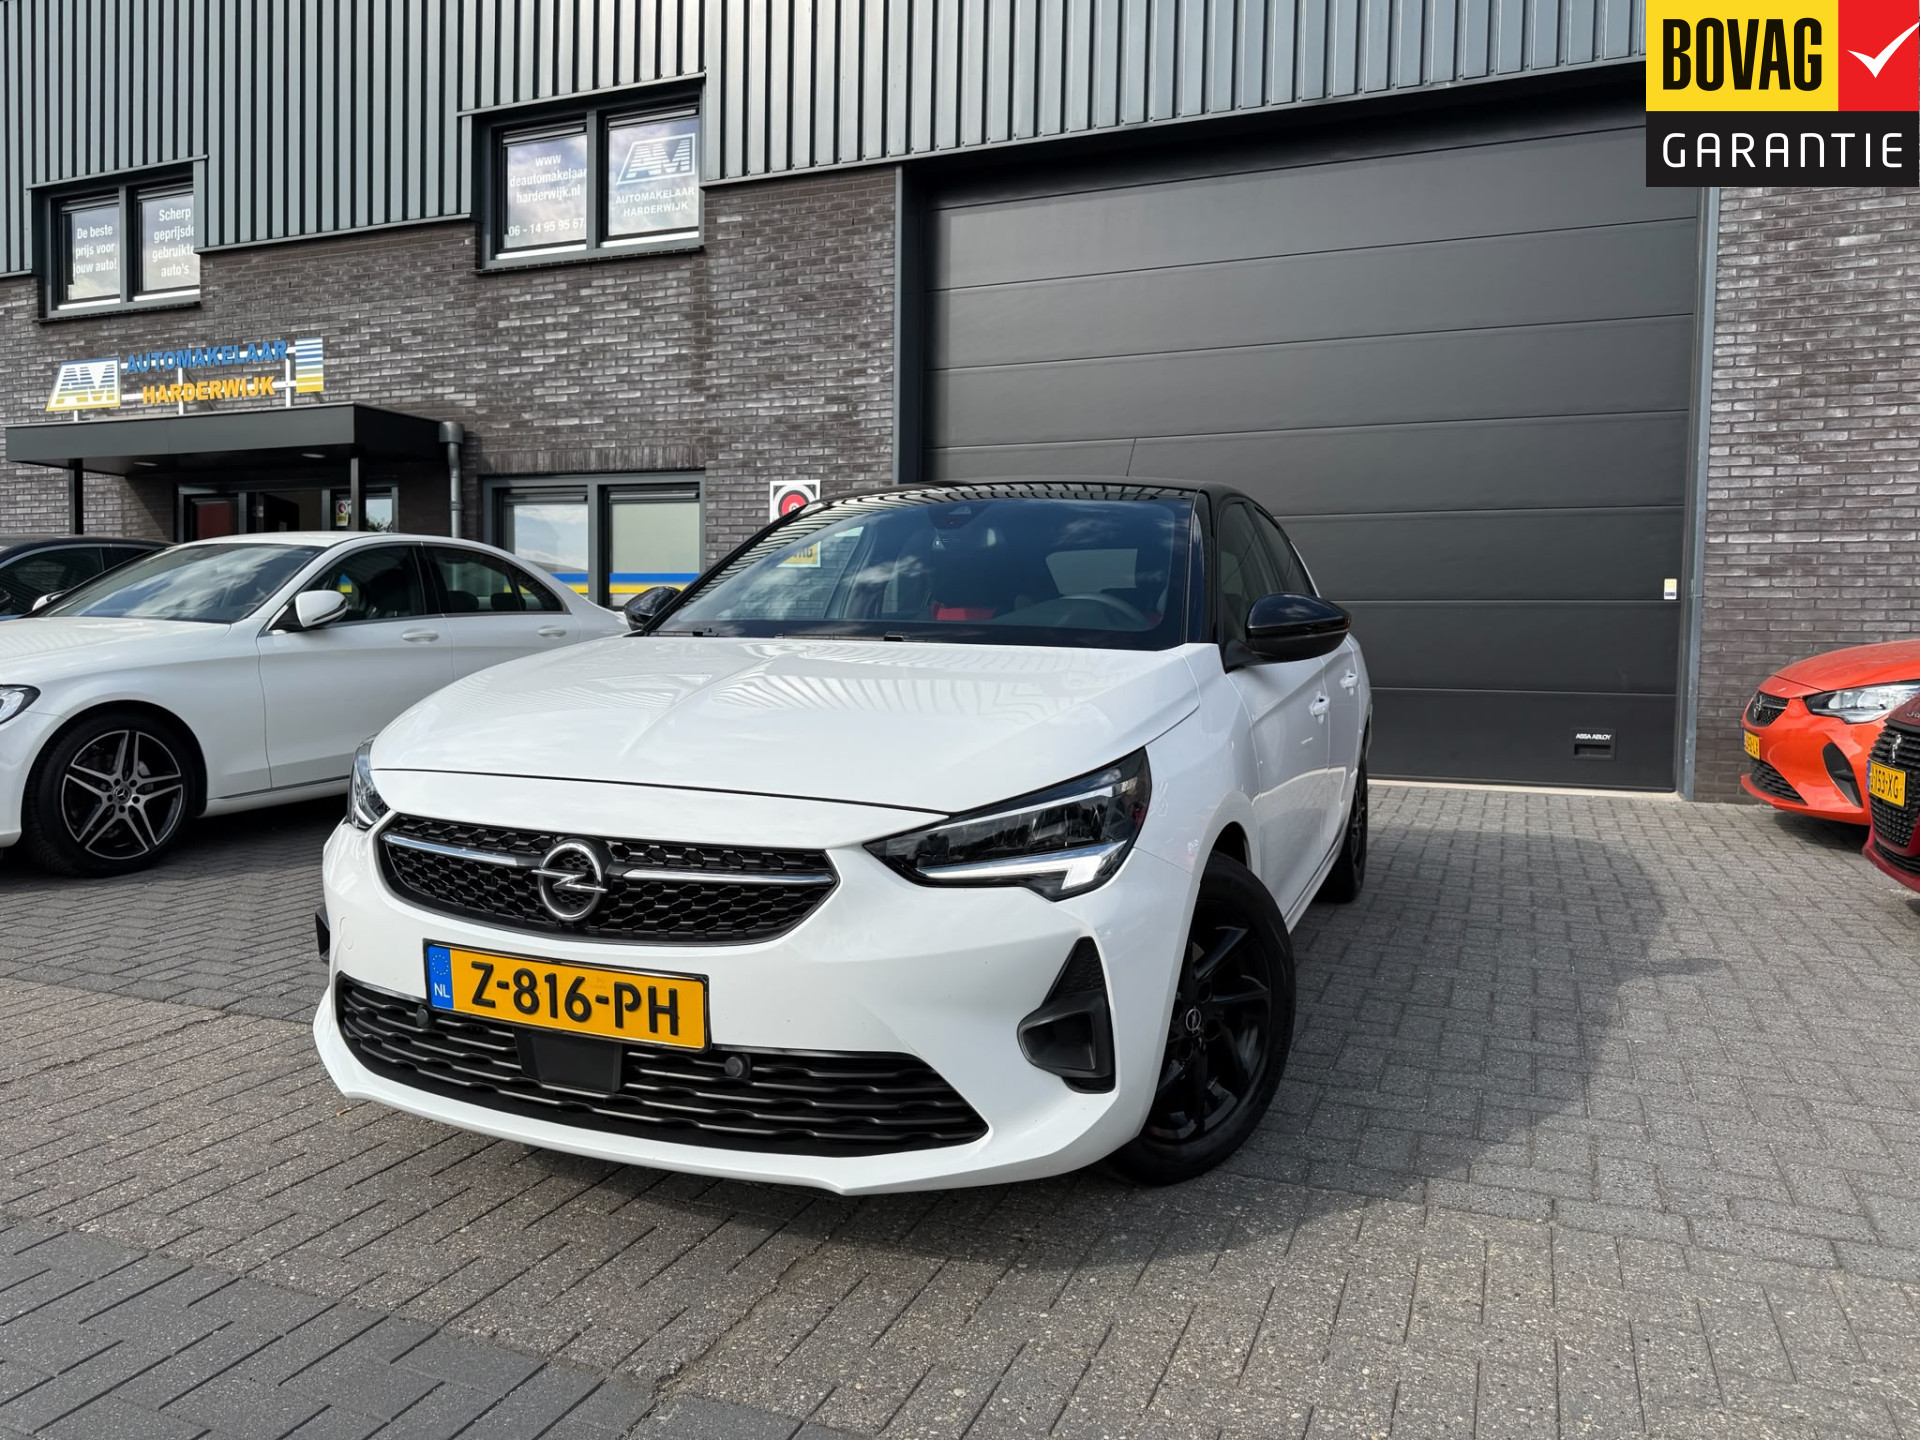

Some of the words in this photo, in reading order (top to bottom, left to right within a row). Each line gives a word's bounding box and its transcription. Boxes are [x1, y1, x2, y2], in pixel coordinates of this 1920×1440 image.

[535, 154, 562, 167] www
[509, 167, 587, 188] deautomakelaar
[516, 184, 581, 204] harderwijk.nl
[615, 186, 695, 204] AUTOMAKELAAR
[159, 208, 191, 222] Scherp
[623, 202, 689, 217] HARDERWIJK
[77, 228, 88, 240] De
[90, 224, 113, 238] beste
[508, 225, 521, 237] 06
[530, 222, 542, 235] 14
[544, 220, 556, 233] 95
[558, 219, 570, 231] 95
[573, 217, 585, 229] 67
[75, 244, 94, 260] prijs
[96, 243, 115, 254] voor
[73, 262, 94, 277] jouw
[95, 257, 118, 272] auto!
[161, 263, 190, 278] auto's
[125, 340, 288, 374] AUTOMAKELAAR
[142, 376, 276, 404] HARDERWIJK
[434, 982, 450, 998] NL
[470, 960, 679, 1036] Z-816-PH
